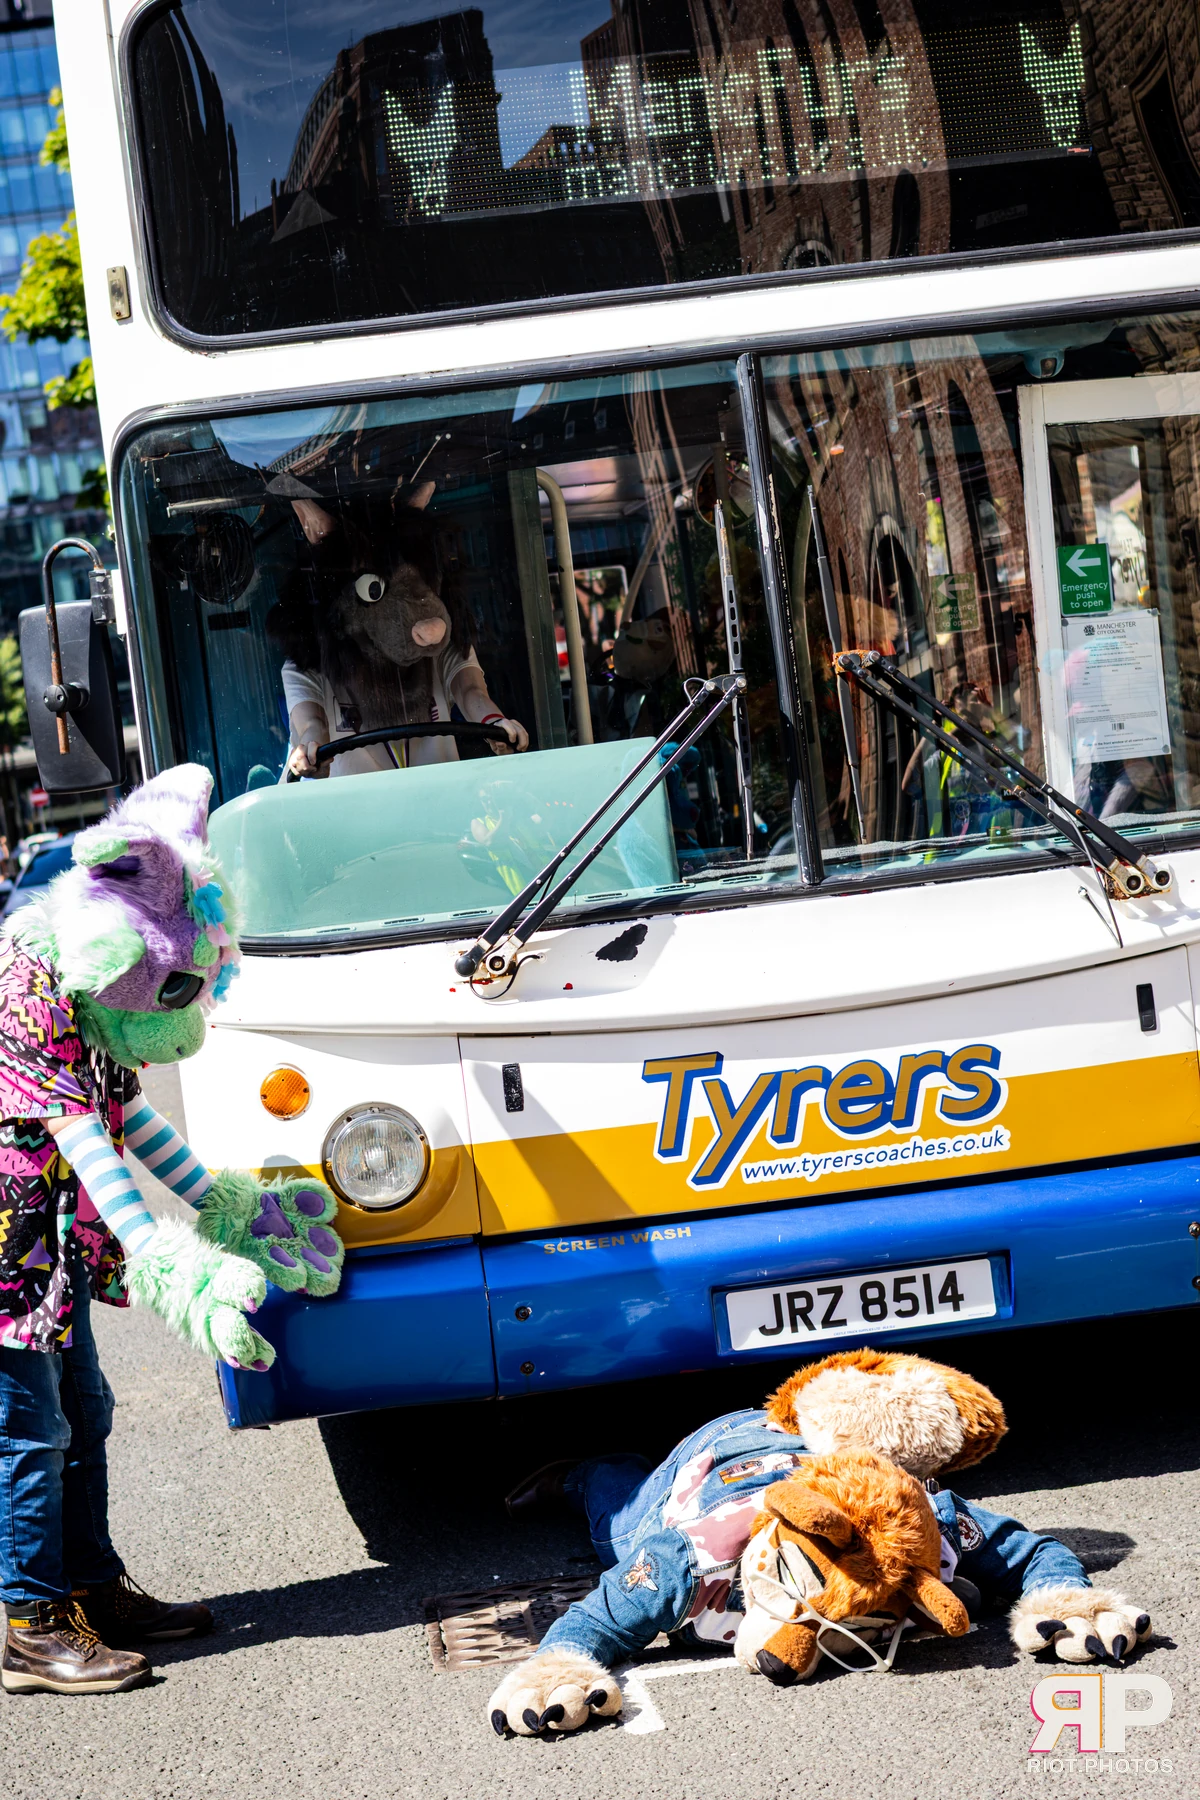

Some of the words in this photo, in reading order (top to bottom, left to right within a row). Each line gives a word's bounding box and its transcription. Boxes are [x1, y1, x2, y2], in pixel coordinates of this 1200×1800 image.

[1061, 582, 1109, 593] Emergency
[1075, 590, 1097, 601] push
[934, 603, 976, 614] Emergency
[1070, 601, 1080, 609] to
[1082, 599, 1104, 609] open
[952, 619, 973, 628] open
[1096, 621, 1137, 630] MANCHESTER
[641, 1044, 1002, 1186] Tyrers
[742, 1128, 1005, 1180] www.tyrerscoaches.co.uk
[543, 1235, 625, 1255] SCREEN
[631, 1226, 692, 1244] WASH
[758, 1284, 847, 1336] JRZ
[859, 1270, 965, 1323] 8514
